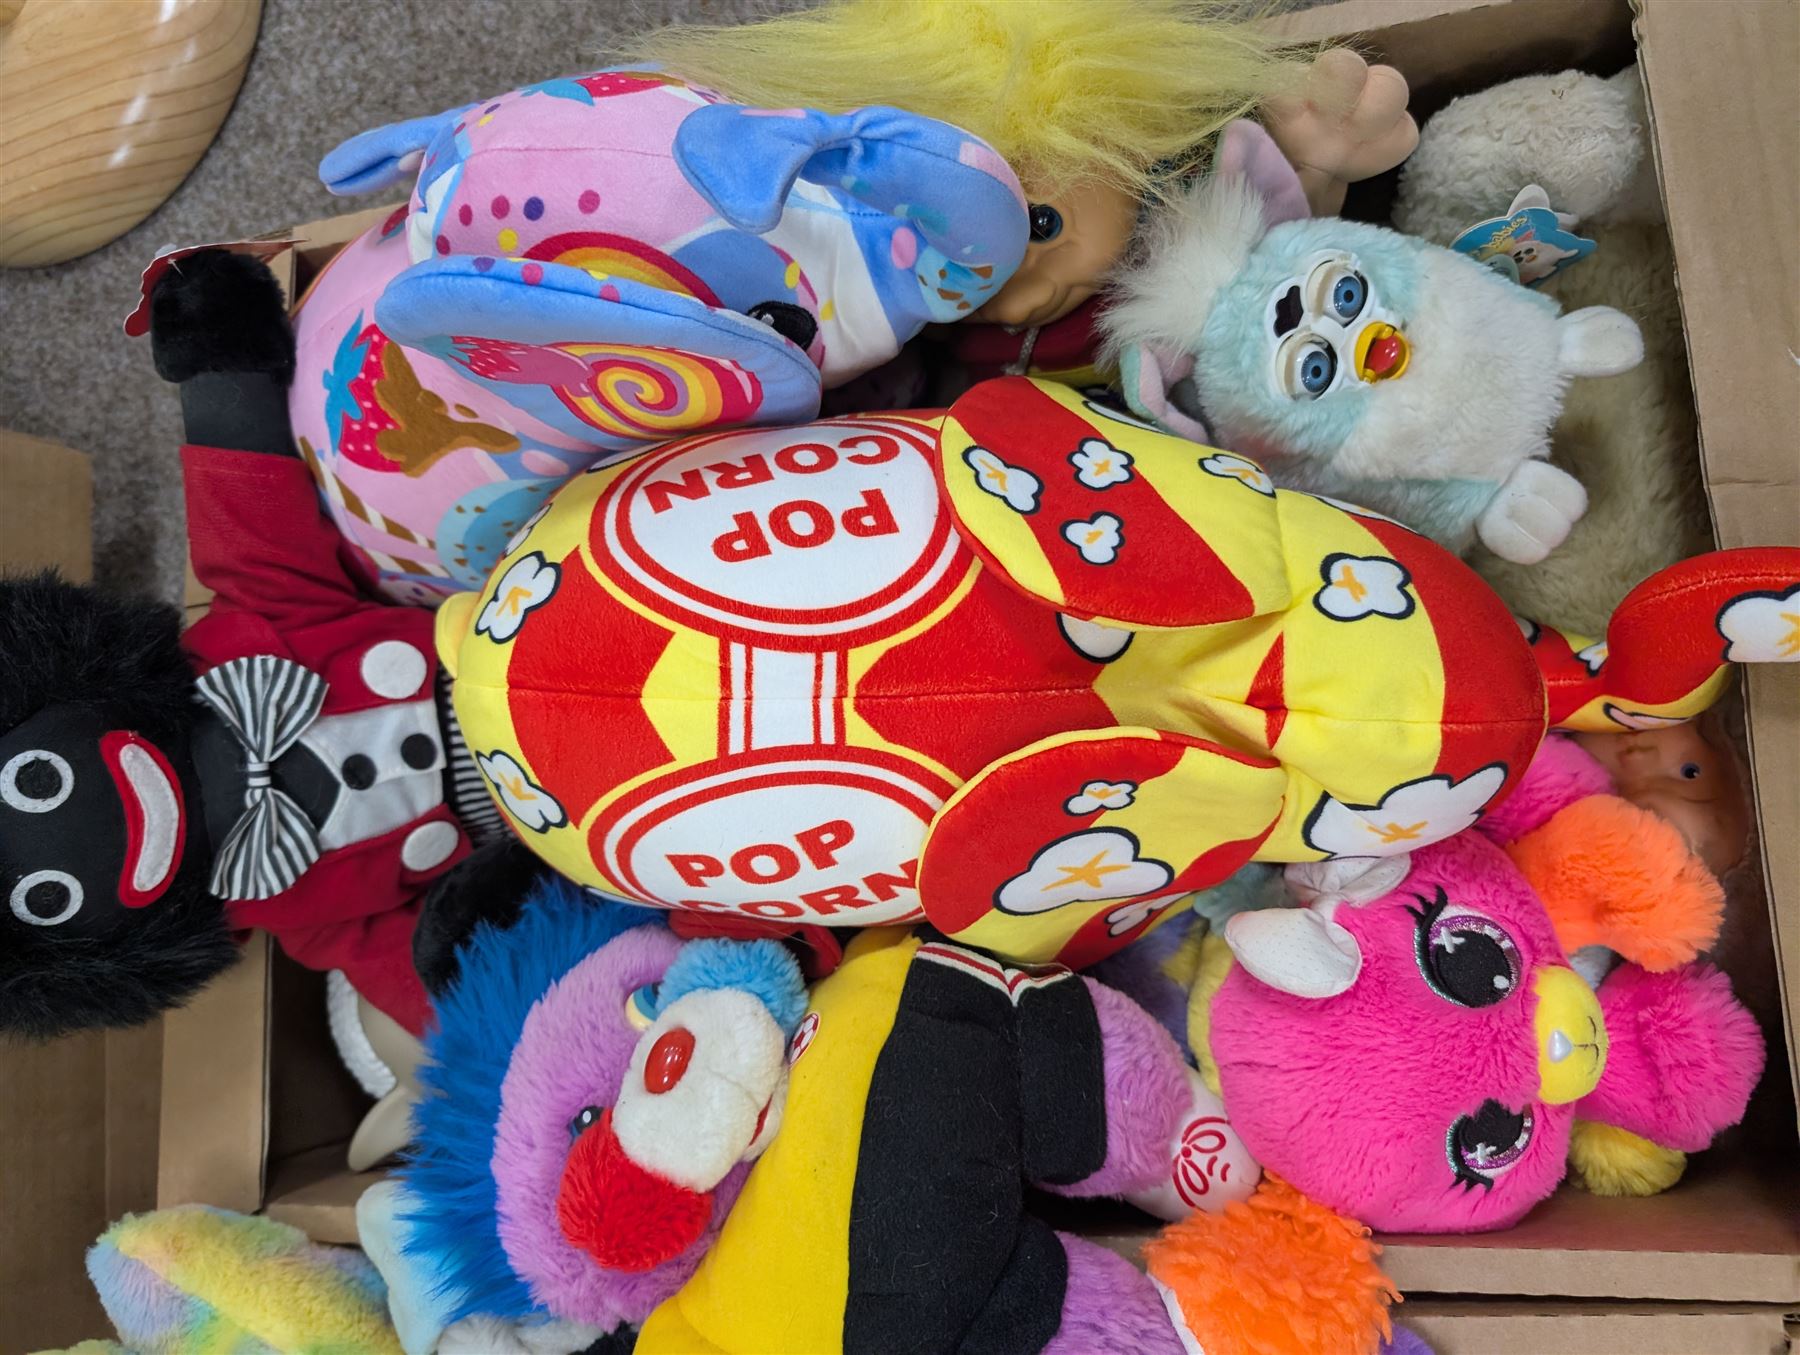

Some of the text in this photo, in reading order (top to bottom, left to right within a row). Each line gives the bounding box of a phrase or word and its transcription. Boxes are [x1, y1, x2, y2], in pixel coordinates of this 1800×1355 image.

[641, 434, 901, 515] CORN
[711, 487, 900, 563] POP
[664, 819, 855, 889] POP
